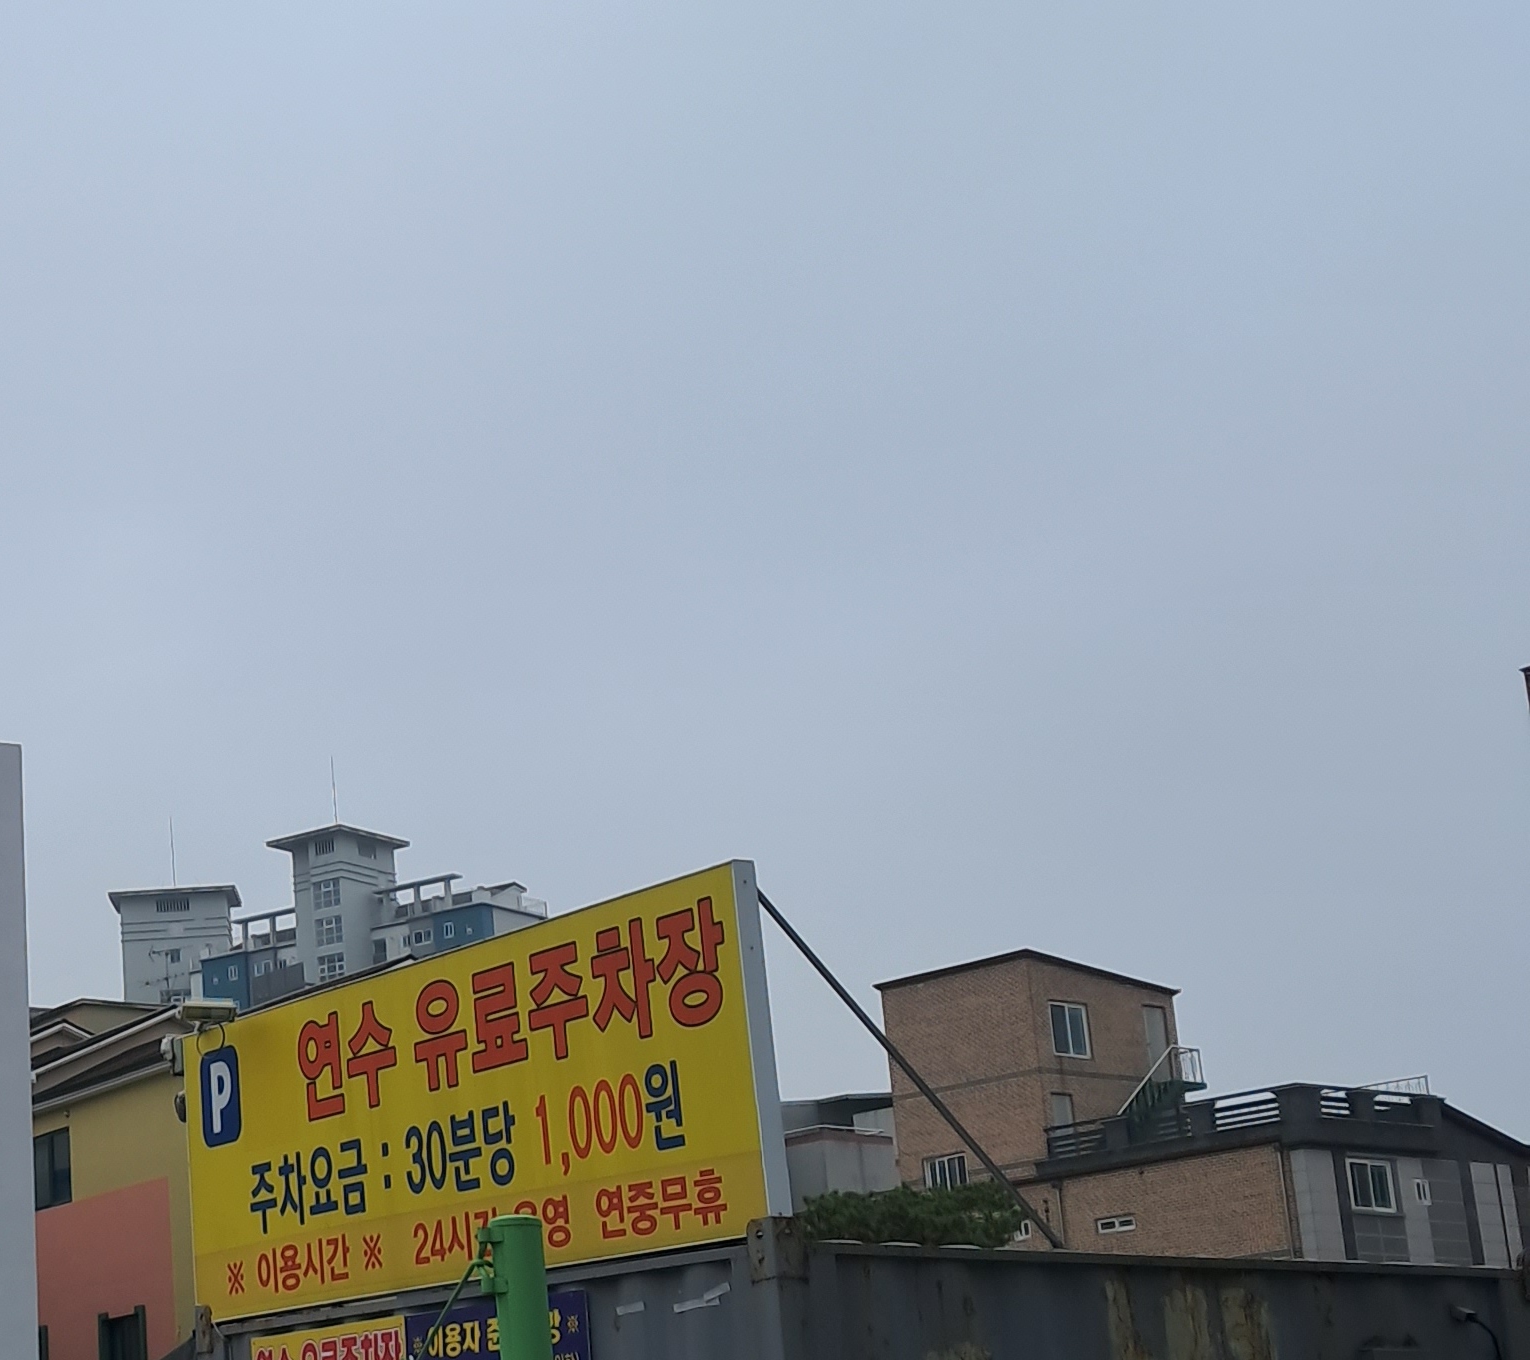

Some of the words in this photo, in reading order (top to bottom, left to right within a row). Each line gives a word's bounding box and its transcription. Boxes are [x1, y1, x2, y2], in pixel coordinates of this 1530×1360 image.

[298, 1000, 397, 1121] 연수
[414, 897, 725, 1092] 유료주차장
[250, 1140, 367, 1234] 주차요금
[405, 1100, 515, 1196] 30분당
[534, 1059, 685, 1178] 1,000원
[257, 1234, 350, 1294] 이용시간
[595, 1168, 728, 1237] 연중무휴
[428, 1320, 481, 1357] 이용자
